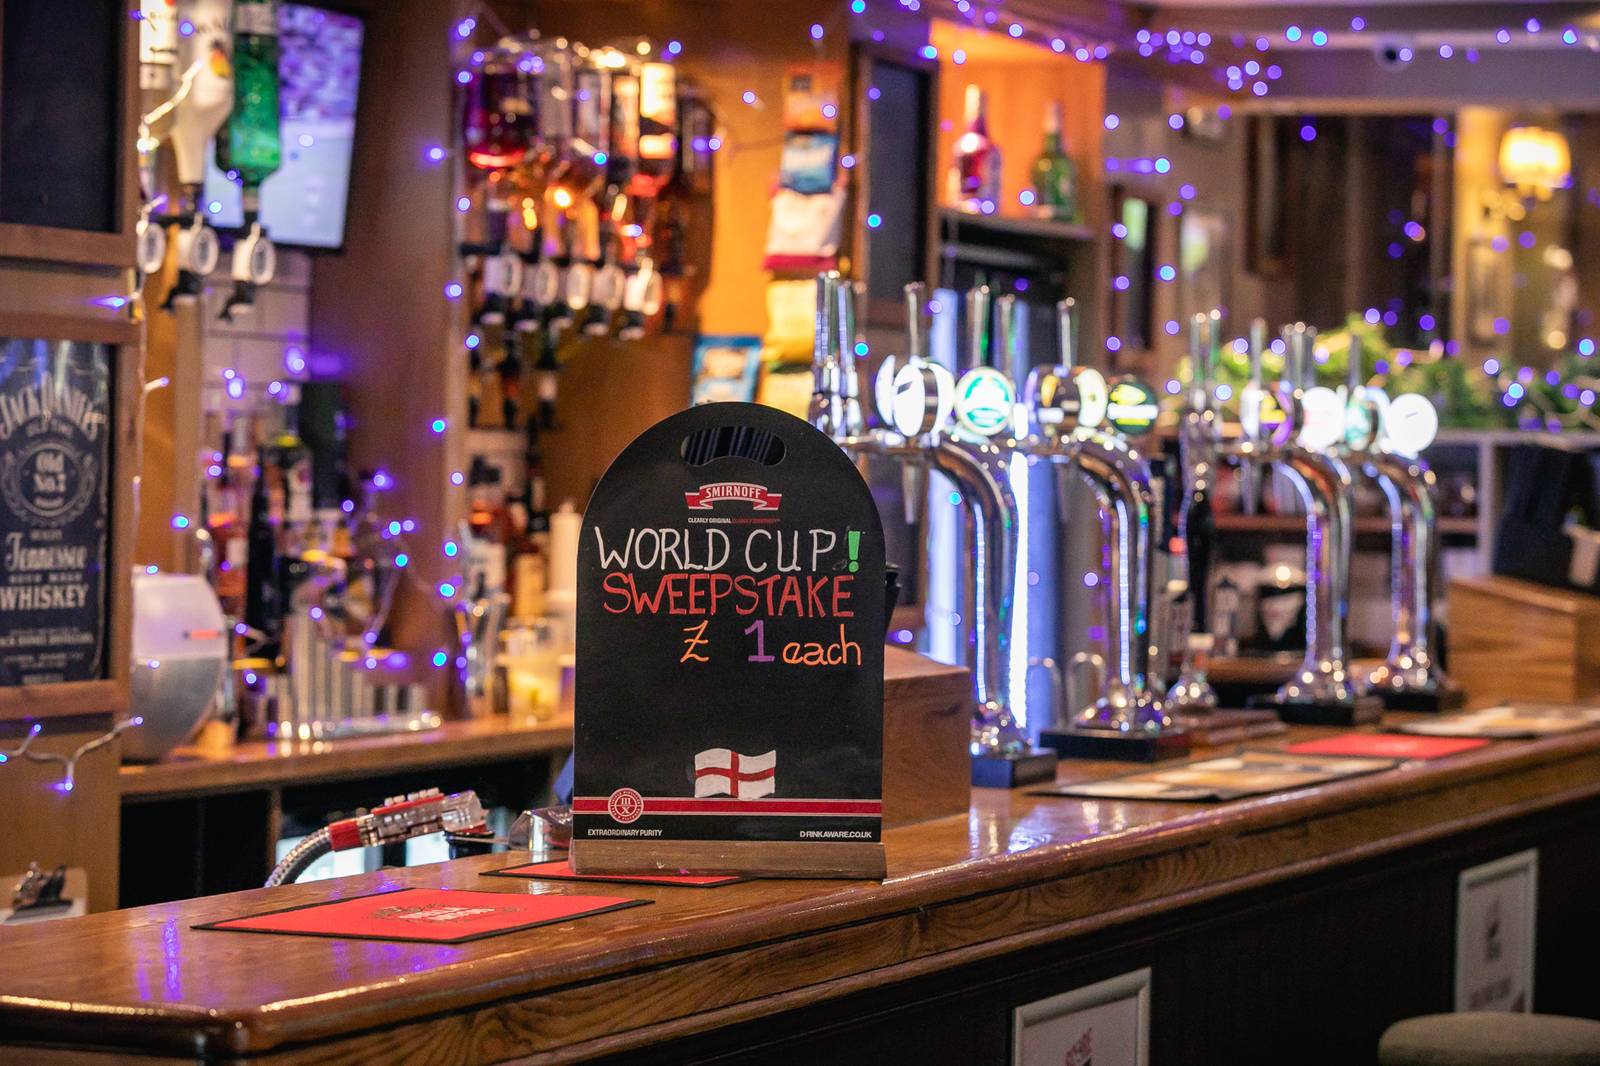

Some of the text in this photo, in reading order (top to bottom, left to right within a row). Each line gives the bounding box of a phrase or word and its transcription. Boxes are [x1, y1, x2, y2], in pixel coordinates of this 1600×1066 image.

[705, 485, 761, 499] SMIRNOFF
[594, 526, 730, 572] WORLD
[0, 583, 89, 611] WHISKEY
[601, 572, 855, 618] SWEEPSTAKE
[743, 618, 776, 663] 1
[781, 623, 863, 667] each
[587, 828, 663, 837] EXTRAORDINARY PURITY
[799, 830, 873, 839] DRINKAWARE.CO.UK
